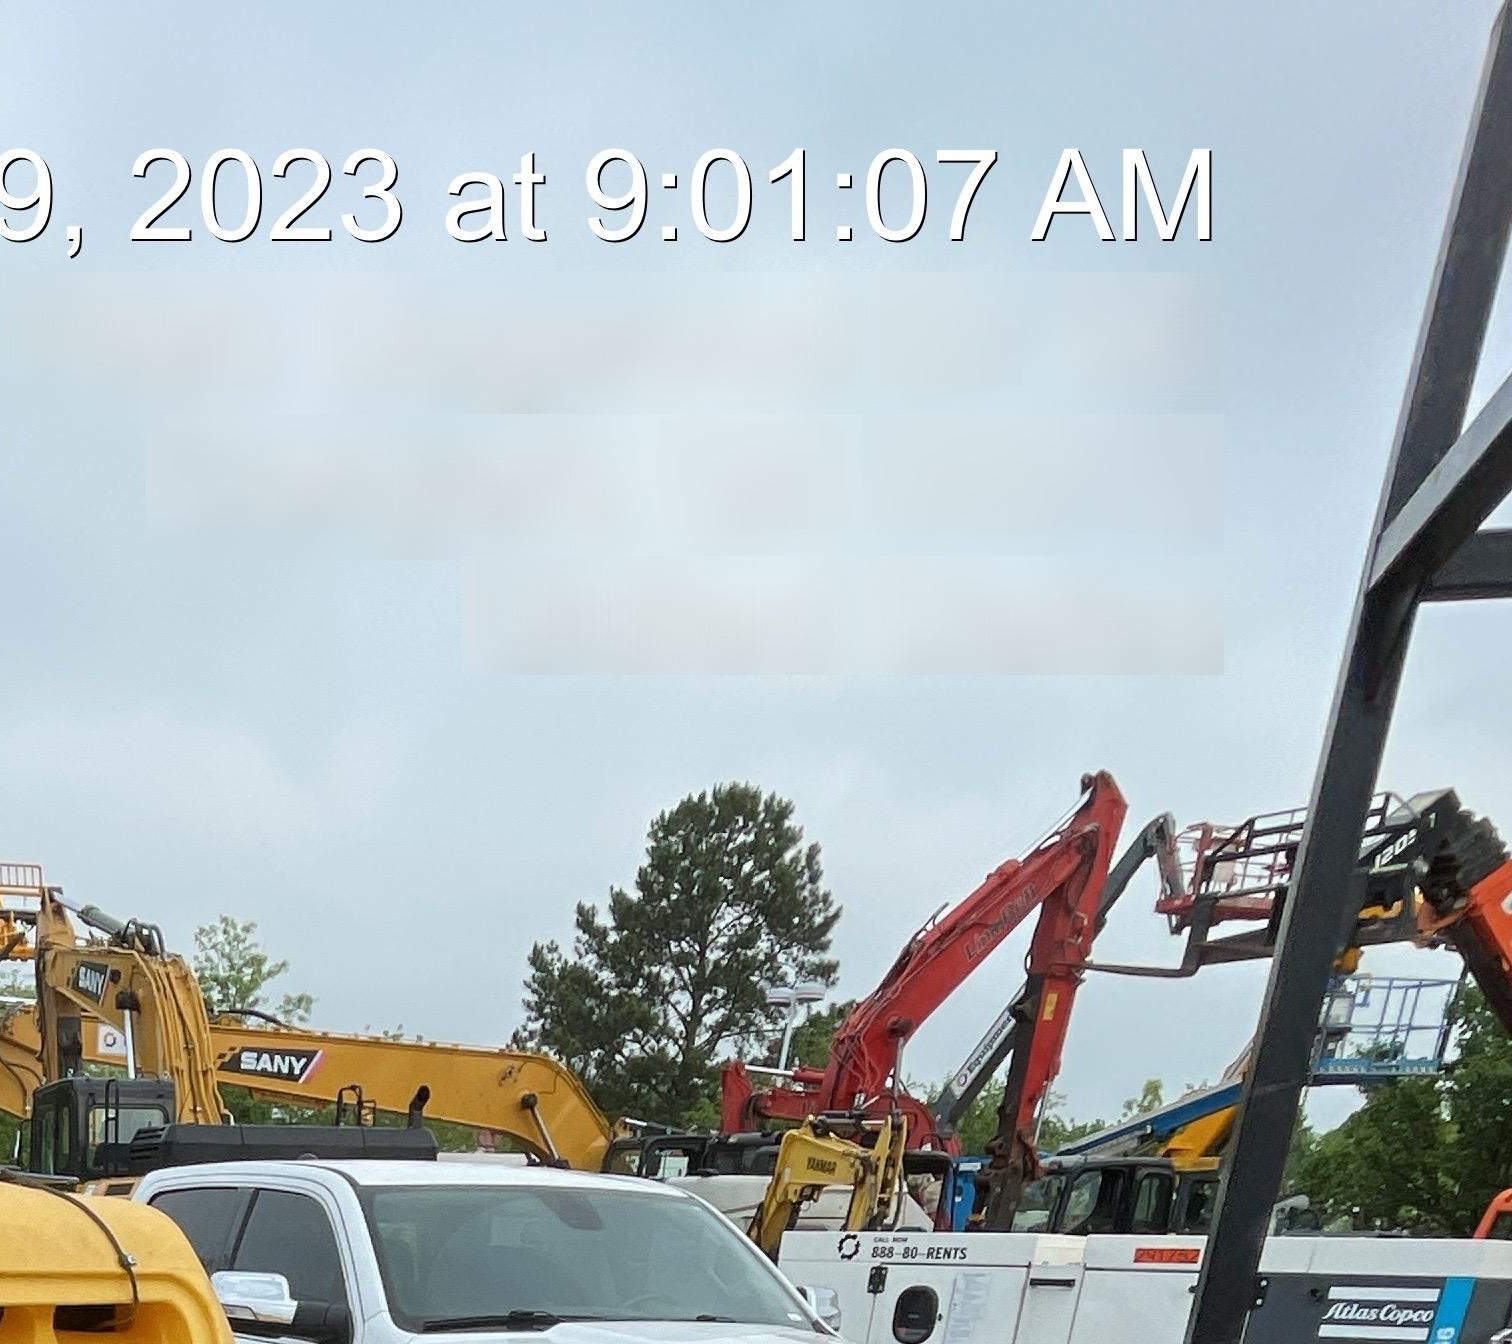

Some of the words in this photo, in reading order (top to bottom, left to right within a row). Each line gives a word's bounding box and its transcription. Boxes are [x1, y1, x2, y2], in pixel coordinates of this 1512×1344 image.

[77, 965, 105, 1001] SANY
[239, 1050, 308, 1076] SANY
[871, 1246, 968, 1260] 888-80-RENTS
[1321, 1301, 1380, 1321] Atlas
[1379, 1303, 1434, 1326] Copco
